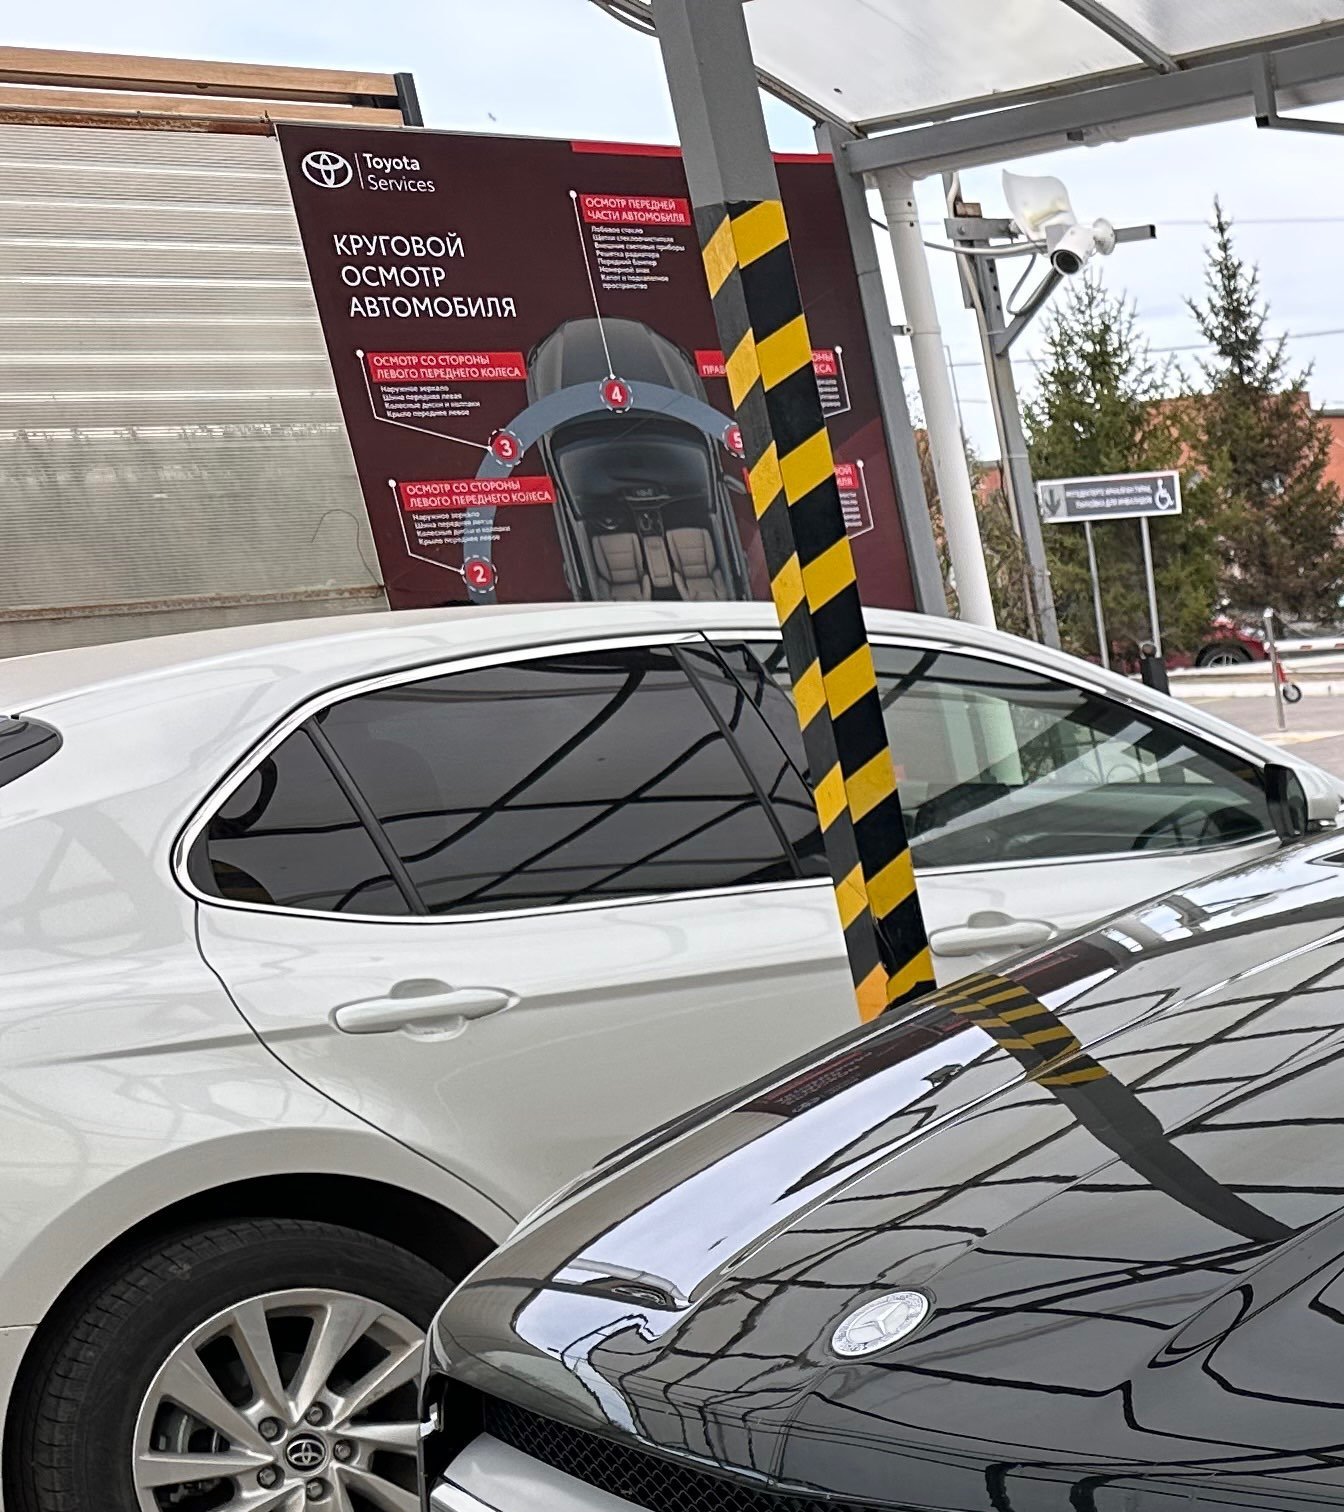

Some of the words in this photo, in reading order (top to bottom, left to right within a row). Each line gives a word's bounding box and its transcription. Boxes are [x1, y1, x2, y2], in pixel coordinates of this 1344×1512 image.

[363, 153, 420, 173] Toyota
[368, 175, 436, 192] Services
[585, 198, 626, 209] ОСМОТР
[628, 199, 676, 211] ПЕРЕДНЕЙ
[588, 211, 620, 221] ЧАСТИ
[622, 212, 685, 223] АВТОМОБИЛЯ
[333, 232, 465, 258] КРУГОВОЙ
[341, 265, 446, 287] ОСМОТР
[349, 297, 517, 318] АВТОМОБИЛЯ
[373, 355, 418, 366] ОСМОТР
[420, 355, 437, 366] СО
[438, 355, 490, 366] СТОРОНЫ
[377, 368, 418, 379] ЛЕВОГО
[420, 368, 480, 380] ПЕРЕДНЕГО
[481, 367, 521, 378] КОЛЕСА
[611, 385, 623, 403] 4
[500, 439, 513, 457] 3
[734, 433, 743, 449] 5
[406, 484, 451, 496] ОСМОТР
[452, 483, 468, 493] СО
[470, 480, 521, 492] СТОРОНЫ
[410, 496, 451, 508] ЛЕВОГО
[452, 494, 510, 506] ПЕРЕДНЕГО
[511, 491, 552, 502] КОЛЕСА
[473, 566, 487, 583] 2
